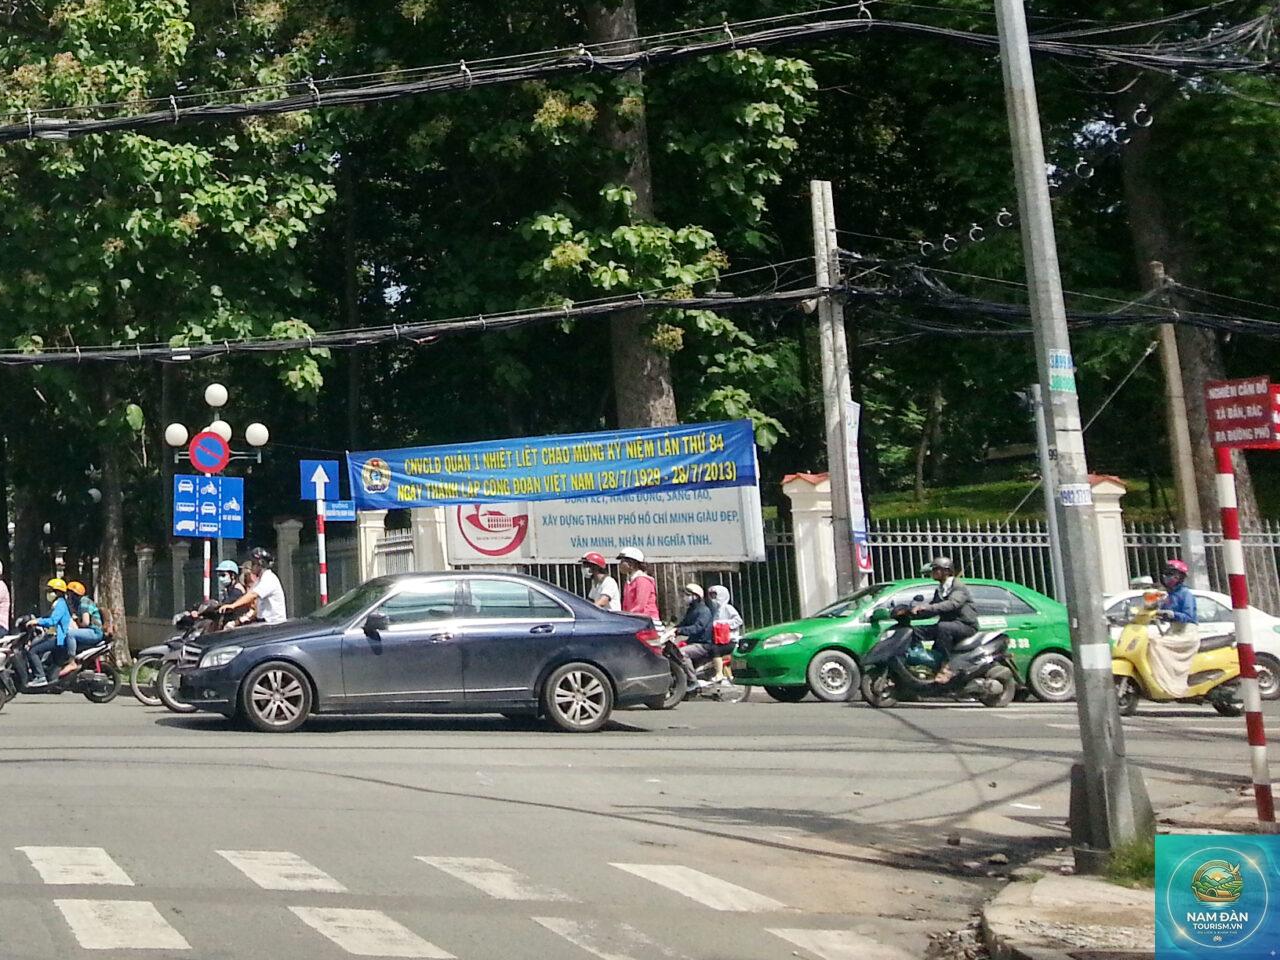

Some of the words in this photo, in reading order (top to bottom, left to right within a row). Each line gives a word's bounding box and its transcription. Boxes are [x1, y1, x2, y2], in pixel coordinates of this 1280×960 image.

[474, 453, 480, 471] 1
[626, 436, 655, 461] NIỆM
[657, 432, 681, 456] LẦN
[683, 431, 708, 454] THỨ
[709, 433, 724, 452] 84
[483, 475, 511, 496] CÔNG
[544, 470, 567, 495] VIỆT
[571, 472, 595, 491] NAM
[671, 461, 737, 485] 28/7/2013)
[542, 512, 557, 526] XÂY
[589, 512, 616, 526] THÀNH
[618, 510, 636, 525] PHỐ
[638, 510, 651, 525] HỒ
[652, 510, 668, 524] CHÍ
[670, 512, 695, 524] MINH
[696, 509, 718, 523] GIÀU
[720, 510, 739, 525] ĐẸP,
[570, 535, 589, 548] VĂN
[590, 536, 617, 548] MINH,
[619, 534, 645, 548] NHÂN
[646, 533, 655, 547] ÁI
[657, 533, 687, 546] NGHĨA
[688, 533, 712, 546] TÌNH.
